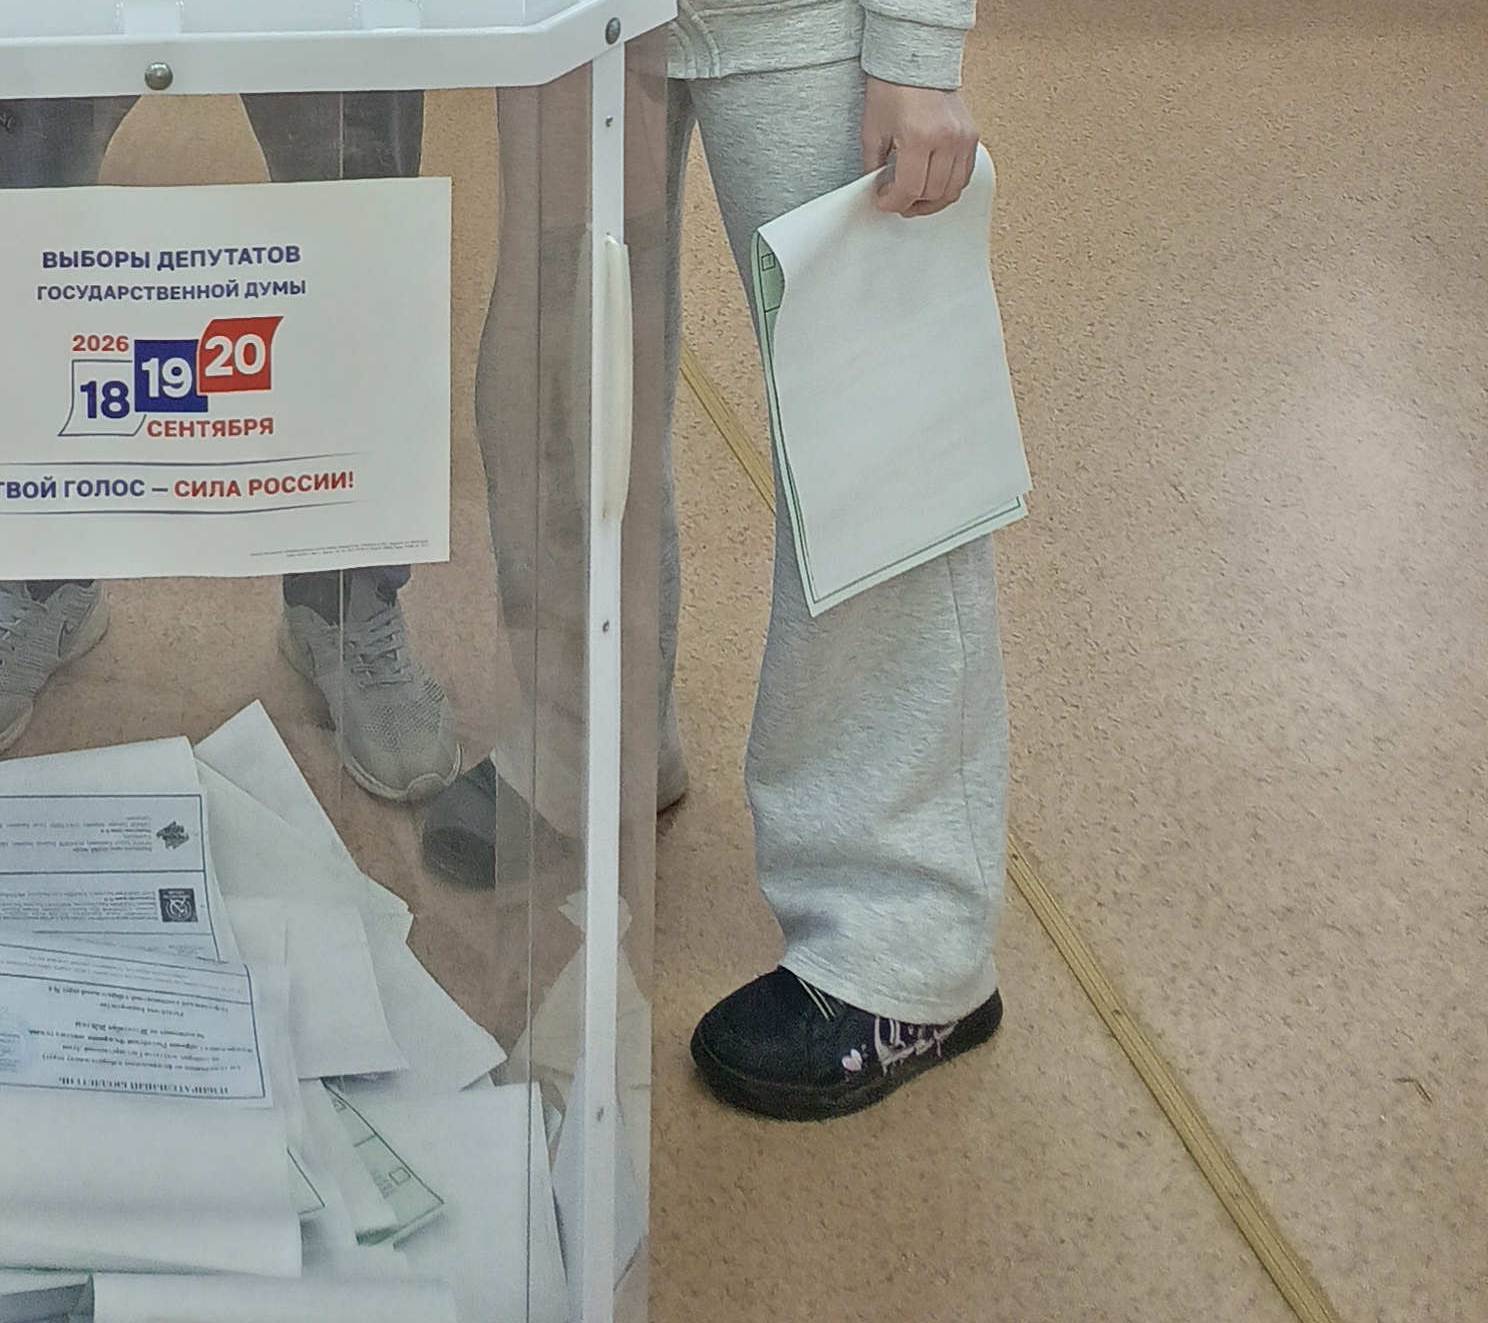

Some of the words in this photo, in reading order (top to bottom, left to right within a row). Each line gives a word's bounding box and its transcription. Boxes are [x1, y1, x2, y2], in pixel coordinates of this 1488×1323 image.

[43, 251, 150, 268] ВЫБОРЫ
[157, 246, 300, 271] ДЕПУТАТОВ
[38, 279, 239, 301] ГОСУДАРСТВЕННОЙ
[245, 280, 305, 299] ДУМЫ
[72, 335, 129, 352] 2026
[80, 381, 130, 418] 18
[141, 358, 192, 397] 19
[205, 336, 265, 376] 20
[147, 417, 274, 437] СЕНТЯБРЯ
[65, 480, 145, 497] ГОЛОС
[175, 480, 241, 497] СИЛА
[249, 471, 353, 496] РОССИИ!
